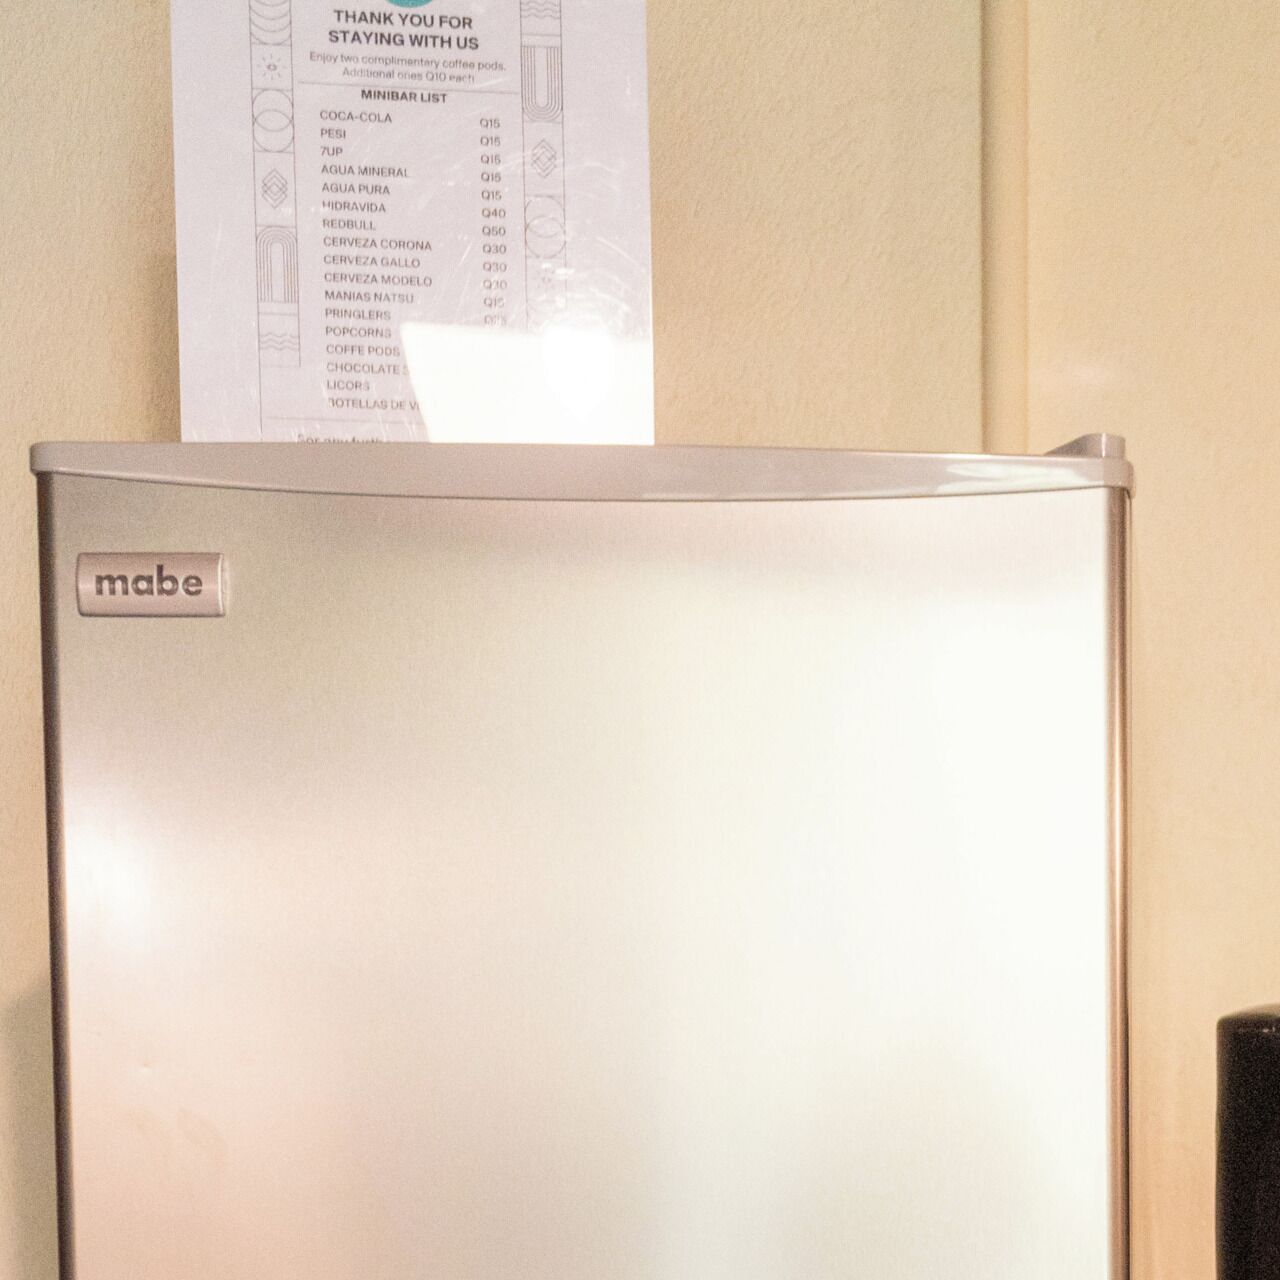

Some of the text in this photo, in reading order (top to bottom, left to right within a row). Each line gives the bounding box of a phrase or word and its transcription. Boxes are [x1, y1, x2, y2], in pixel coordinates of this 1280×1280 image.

[334, 9, 473, 30] THANK YOU FOR
[328, 30, 479, 50] STAYING WITH US
[309, 51, 507, 72] Enjoy two complimentary coffee pods.
[342, 66, 395, 79] Additional
[397, 70, 423, 80] ones
[425, 70, 447, 82] Q10
[361, 89, 447, 104] MINIBAR LIST
[320, 110, 501, 130] COCA-COLA Q15
[320, 128, 501, 148] PESI Q15
[320, 146, 501, 166] 7UP Q15
[321, 164, 502, 183] AGUA MINERAL Q15
[321, 182, 502, 201] AGUA PURA Q15
[322, 201, 507, 219] HIDRAVIDA Q40
[322, 218, 507, 237] REDBULL Q50
[323, 236, 507, 255] CERVEZA CORONA Q30
[323, 254, 507, 273] CERVEZA GALLO Q30
[324, 272, 378, 284] CERVEZA
[381, 275, 433, 287] MODELO
[324, 290, 371, 302] MANIAS
[373, 292, 415, 304] NATSU
[325, 308, 391, 321] PRINGLERS
[325, 326, 392, 339] POPCORNS
[326, 344, 400, 357] COFFE PODS
[326, 362, 400, 375] CHOCOLATE
[326, 380, 370, 391] LICORS
[95, 564, 203, 596] mabe
